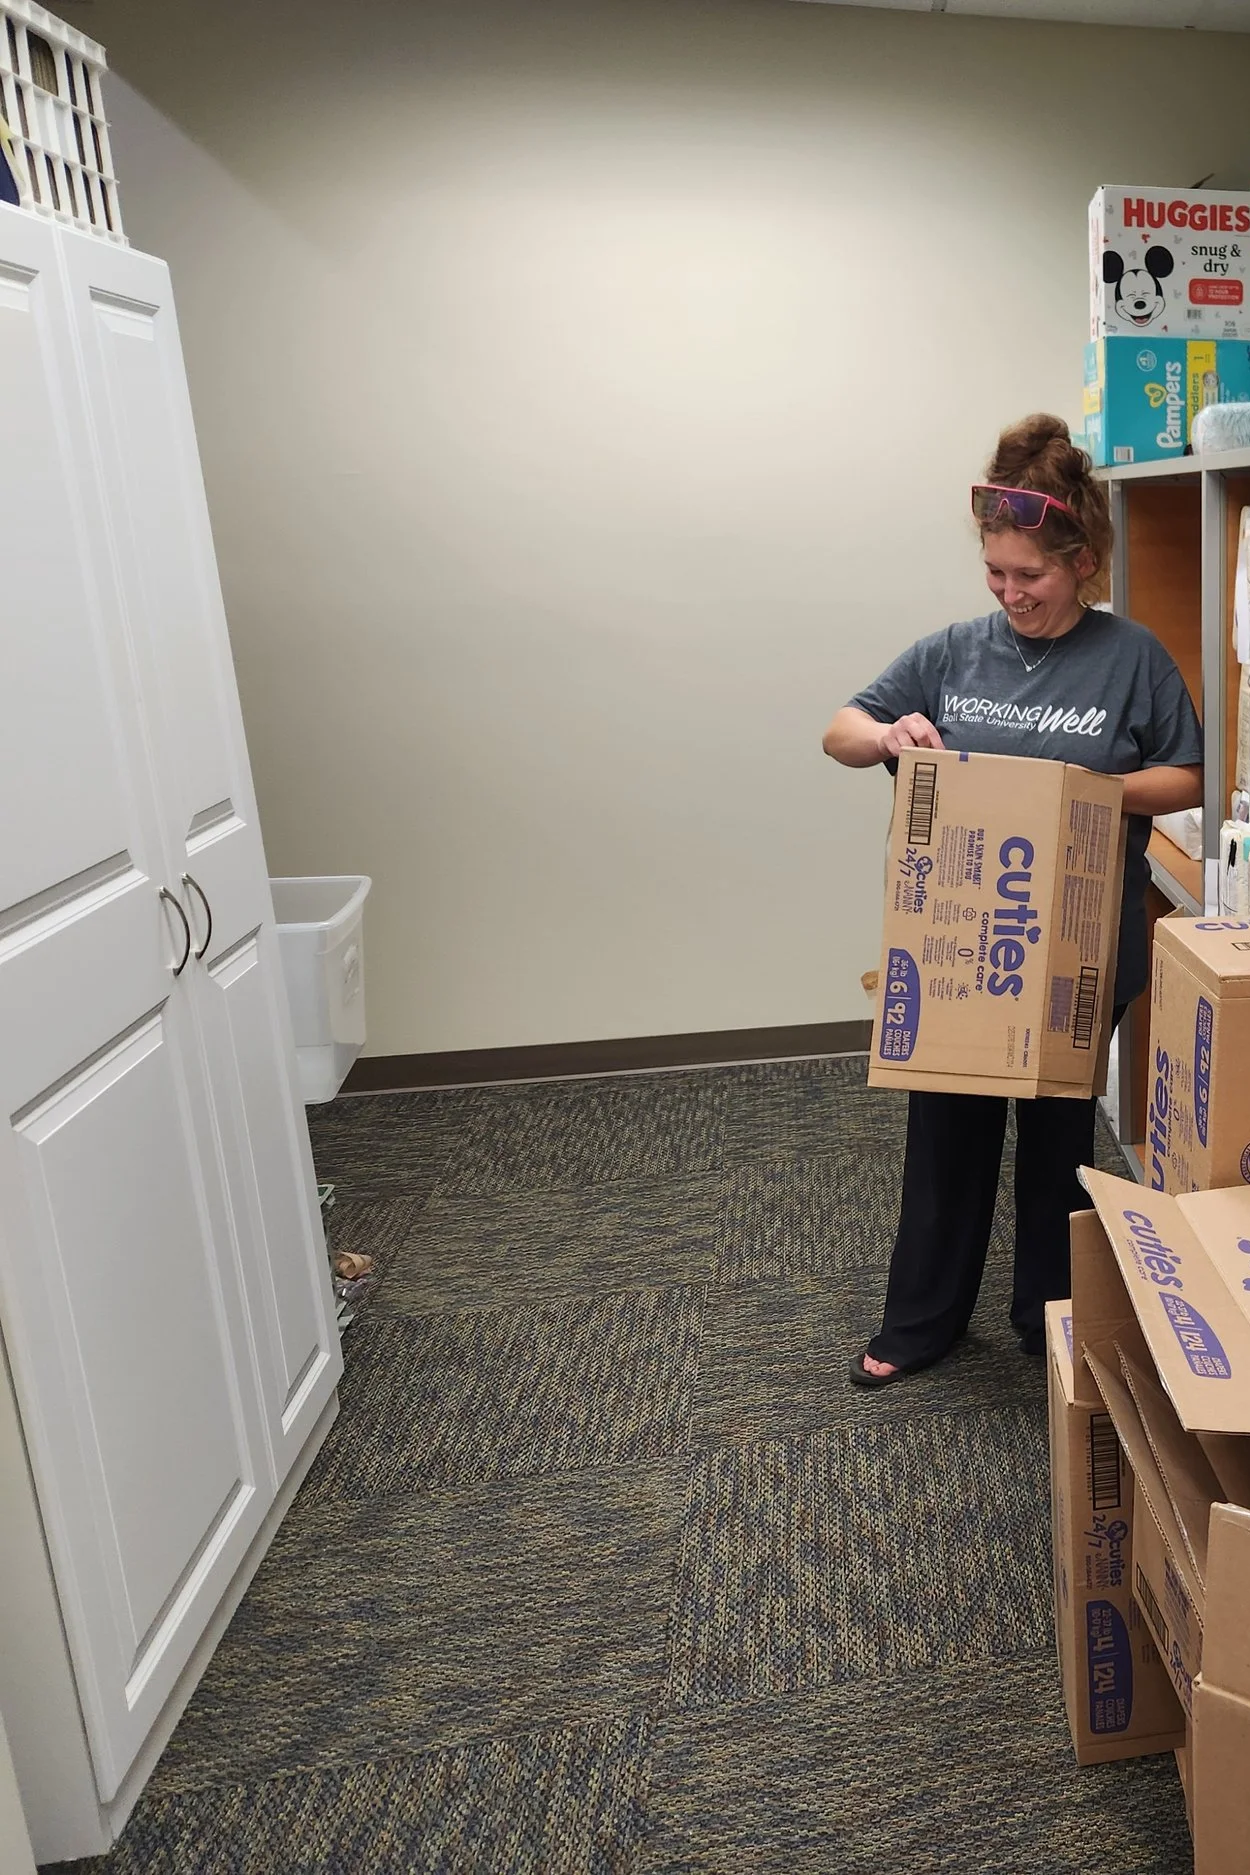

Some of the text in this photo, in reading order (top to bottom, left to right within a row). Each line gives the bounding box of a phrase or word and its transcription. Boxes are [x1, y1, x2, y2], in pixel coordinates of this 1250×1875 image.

[1191, 244, 1241, 260] snug &
[1203, 259, 1230, 276] dry
[1156, 360, 1184, 449] Pampers
[942, 712, 1037, 732] Ball State University
[944, 694, 1107, 737] WORKING Well
[898, 848, 918, 877] 24/7
[964, 830, 974, 880] PROMISE TO YOU
[975, 844, 984, 861] SKIN
[913, 873, 928, 914] cuties
[987, 836, 1041, 997] cuties
[975, 912, 990, 992] complete care
[886, 981, 908, 1024] 6 92
[892, 1029, 902, 1056] COUCHES
[901, 1030, 911, 1056] DIAPERS
[1199, 1045, 1210, 1075] 92
[1199, 1085, 1208, 1104] 6
[1150, 1046, 1170, 1193] uties
[1123, 1210, 1183, 1290] cuties
[1180, 1330, 1208, 1351] 124
[1084, 1514, 1107, 1550] 24/7
[1109, 1541, 1126, 1588] cuties
[1093, 1635, 1116, 1694] 4 124
